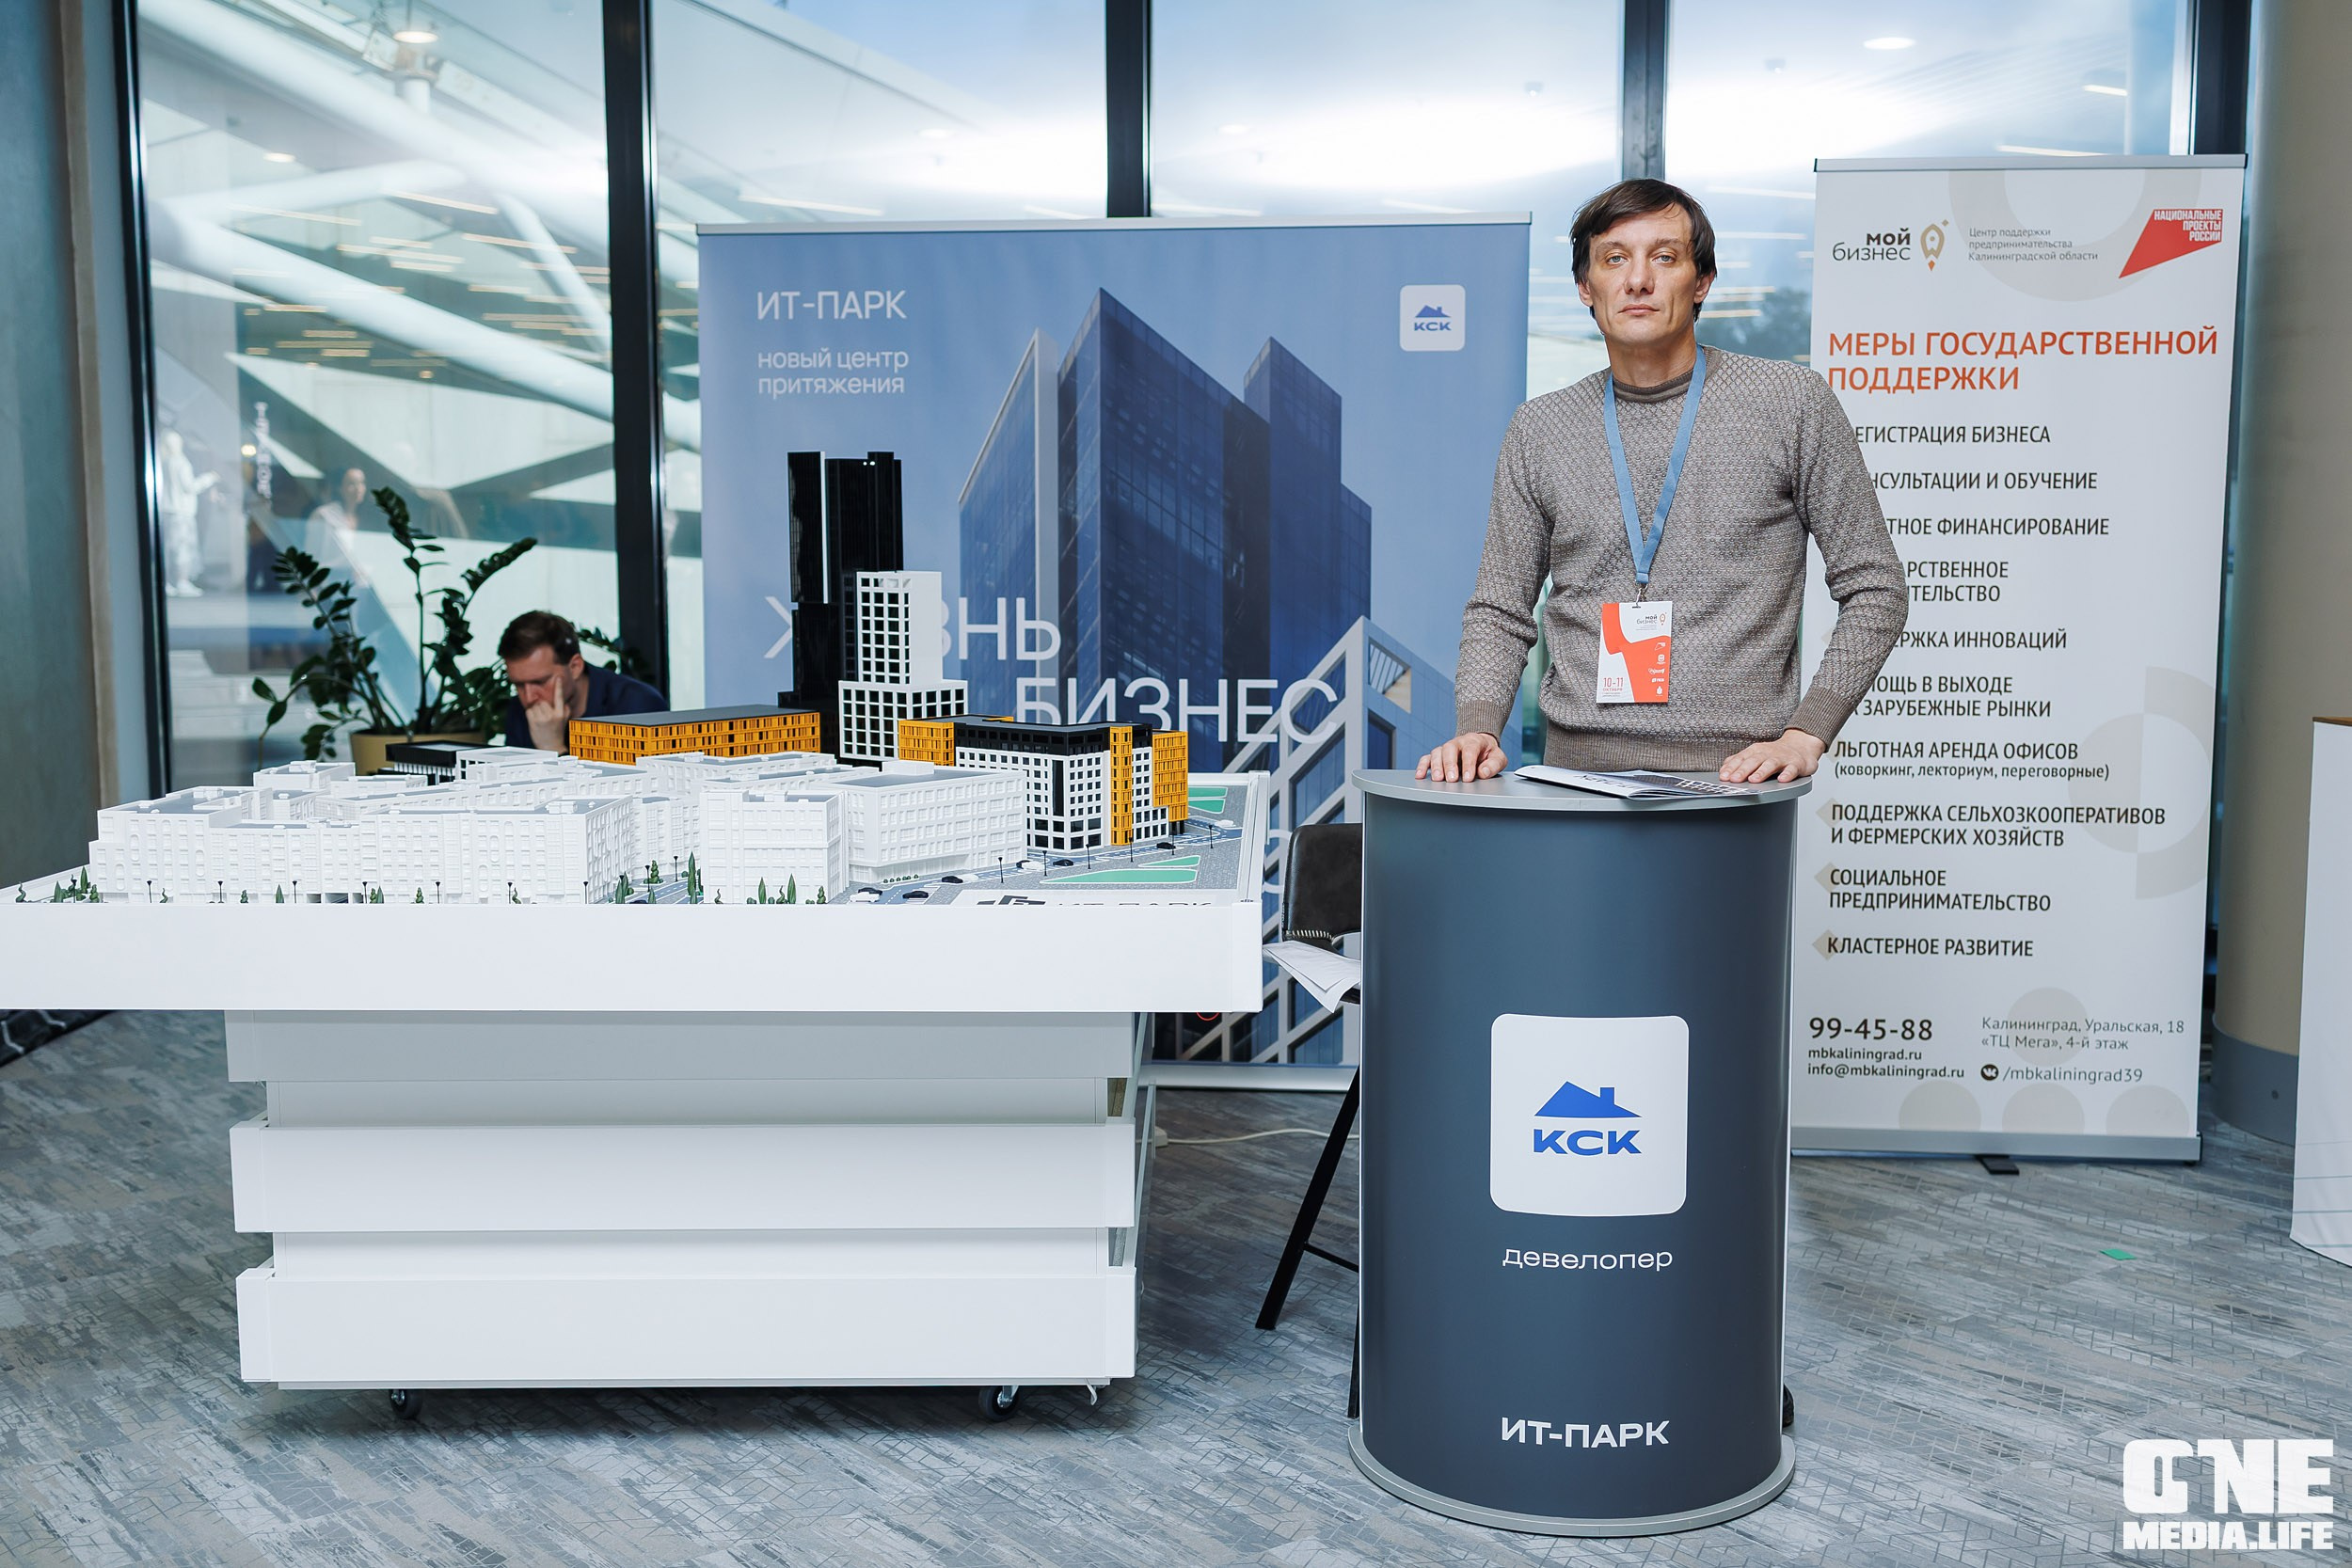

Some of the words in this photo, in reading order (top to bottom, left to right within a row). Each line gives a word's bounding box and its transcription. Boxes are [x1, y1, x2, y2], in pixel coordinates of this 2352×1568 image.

[2154, 210, 2221, 221] НАЦИОНАЛЬНЫЕ
[1970, 229, 1996, 238] Центр
[2182, 221, 2220, 231] ПРОЕКТЫ
[1867, 228, 1910, 245] мой
[1969, 241, 2072, 250] предпринимательства
[2189, 231, 2222, 242] РОССИИ
[1833, 241, 1910, 261] бизнес
[1969, 251, 2056, 262] Калининградской
[2059, 251, 2098, 260] области
[758, 291, 906, 320] ИТ-ПАРК
[1830, 333, 1915, 356] МЕРЫ
[1927, 325, 2217, 358] ГОСУДАРСТВЕННОЙ
[758, 348, 831, 369] новый
[837, 352, 909, 373] центр
[759, 377, 903, 400] притяжения
[1829, 367, 2018, 394] ПОДДЕРЖКИ
[1855, 426, 1966, 446] ЕГИСТРАЦИЯ
[1973, 426, 2050, 442] БИЗНЕСА
[1871, 472, 1980, 492] НСУЛЬТАЦИИ
[1987, 473, 1997, 488] И
[2005, 473, 2097, 489] ОБУЧЕНИЕ
[1885, 518, 1931, 535] ТНОЕ
[1938, 518, 2109, 534] ФИНАНСИРОВАНИЕ
[1907, 561, 2009, 578] РСТВЕННОЕ
[1908, 584, 2000, 602] ТЕЛЬСТВО
[1955, 628, 2066, 650] ИННОВАЦИЙ
[1603, 676, 1624, 688] 10-11
[1871, 675, 1916, 695] ОЩЬ
[1923, 676, 1931, 692] В
[1939, 676, 2012, 695] ВЫХОДЕ
[1016, 677, 1338, 744] БИЗНЕС
[1863, 700, 1980, 716] ЗАРУБЕЖНЫЕ
[1988, 701, 2050, 717] РЫНКИ
[1835, 741, 1923, 758] ЛЬГОТНАЯ
[1929, 742, 1998, 761] АРЕНДА
[2004, 743, 2077, 759] ОФИСОВ
[1836, 762, 1915, 779] (коворкинг,
[1918, 766, 1998, 781] лекториум,
[2002, 765, 2108, 781] переговорные)
[1833, 804, 1942, 823] ПОДДЕРЖКА
[1947, 806, 2165, 824] СЕЛЬХОЗКООПЕРАТИВОВ
[1832, 828, 1842, 843] И
[1849, 828, 1966, 845] ФЕРМЕРСКИХ
[1973, 827, 2063, 846] ХОЗЯЙСТВ
[1831, 869, 1946, 888] СОЦИАЛЬНОЕ
[1830, 892, 2050, 911] ПРЕДПРИНИМАТЕЛЬСТВО
[1828, 937, 1939, 954] КЛАСТЕРНОЕ
[1946, 939, 2033, 956] РАЗВИТИЕ
[1810, 1018, 1931, 1040] 99-45-88
[1983, 1018, 2081, 1033] Калининград,
[2085, 1019, 2162, 1034] Уральская,
[2169, 1021, 2184, 1033] 18
[1981, 1035, 2010, 1049] «ТЦ
[2015, 1036, 2061, 1050] Мега»,
[2066, 1036, 2090, 1049] 4-й
[2095, 1037, 2129, 1050] этаж
[1809, 1048, 1921, 1064] mbkaliningrad.ru
[1808, 1063, 1963, 1079] info@mbkaliningrad.ru
[2003, 1067, 2142, 1085] /mbkaliningrad39
[1534, 1129, 1642, 1156] КСК
[1502, 1249, 1672, 1271] девелопер
[1502, 1418, 1669, 1448] ИТ-ПАРК
